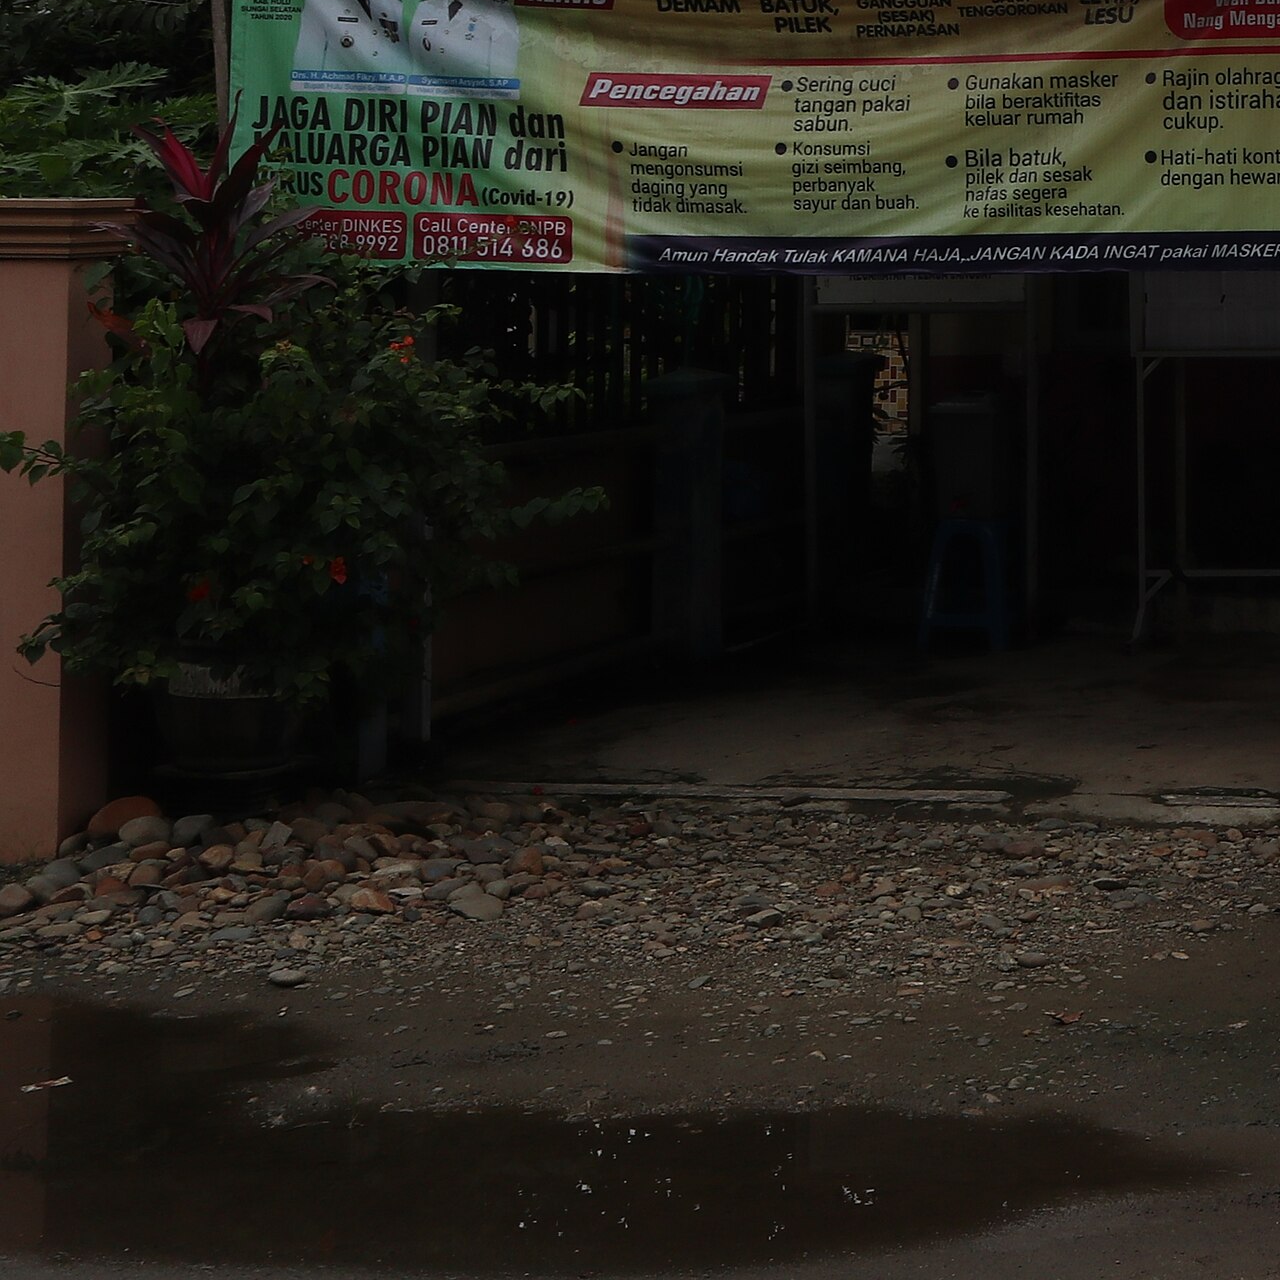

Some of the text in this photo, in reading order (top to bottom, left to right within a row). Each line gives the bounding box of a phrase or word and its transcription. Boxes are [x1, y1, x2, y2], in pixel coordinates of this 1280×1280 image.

[877, 8, 936, 25] (SESAK)
[957, 0, 1069, 19] TENGGOROKAN
[1085, 4, 1134, 25] LESU
[774, 16, 833, 34] PILEK
[856, 22, 960, 39] PERNAPASAN
[1183, 12, 1224, 30] Nang
[796, 74, 897, 97] Sering cuci
[964, 71, 1119, 91] Gunakan masker
[1162, 70, 1209, 90] Rajin
[588, 78, 762, 104] Pencegahan
[965, 91, 1101, 110] bila beraktifitas
[1162, 90, 1202, 110] dan
[794, 94, 911, 117] tangan pakai
[252, 96, 566, 139] JAGA DIRI PIAN dan
[793, 115, 853, 133] sabun.
[964, 108, 1084, 128] keluar rumah
[1163, 112, 1224, 133] cukup.
[423, 135, 492, 169] PIAN
[504, 138, 568, 172] dari
[629, 142, 688, 161] Jangan
[792, 141, 871, 157] Konsumsi
[964, 147, 1067, 170] Bila batuk,
[1160, 148, 1238, 166] Hati-hati
[630, 159, 743, 180] mengonsumsi
[791, 158, 906, 179] gizi seimbang,
[965, 166, 1093, 188] pilek dan sesak
[327, 169, 575, 209] CORONA (Covid-19)
[631, 178, 728, 200] daging yang
[792, 177, 876, 199] perbanyak
[1160, 169, 1225, 190] dengan
[792, 194, 919, 215] sayur dan buah.
[965, 185, 1068, 205] nafas segera
[632, 197, 748, 215] tidak dimasak.
[963, 201, 1125, 218] ke fasilitas kesehatan.
[342, 218, 403, 234] DINKES
[419, 217, 451, 233] Call
[355, 234, 399, 253] 9992
[422, 236, 564, 258] 0811 514 686
[658, 247, 708, 263] Amun
[712, 248, 779, 263] Handak
[783, 249, 829, 264] Tulak
[830, 248, 908, 264] KAMANA
[1049, 245, 1099, 260] KADA
[1103, 243, 1159, 260] INGAT
[1160, 243, 1208, 262] pakai
